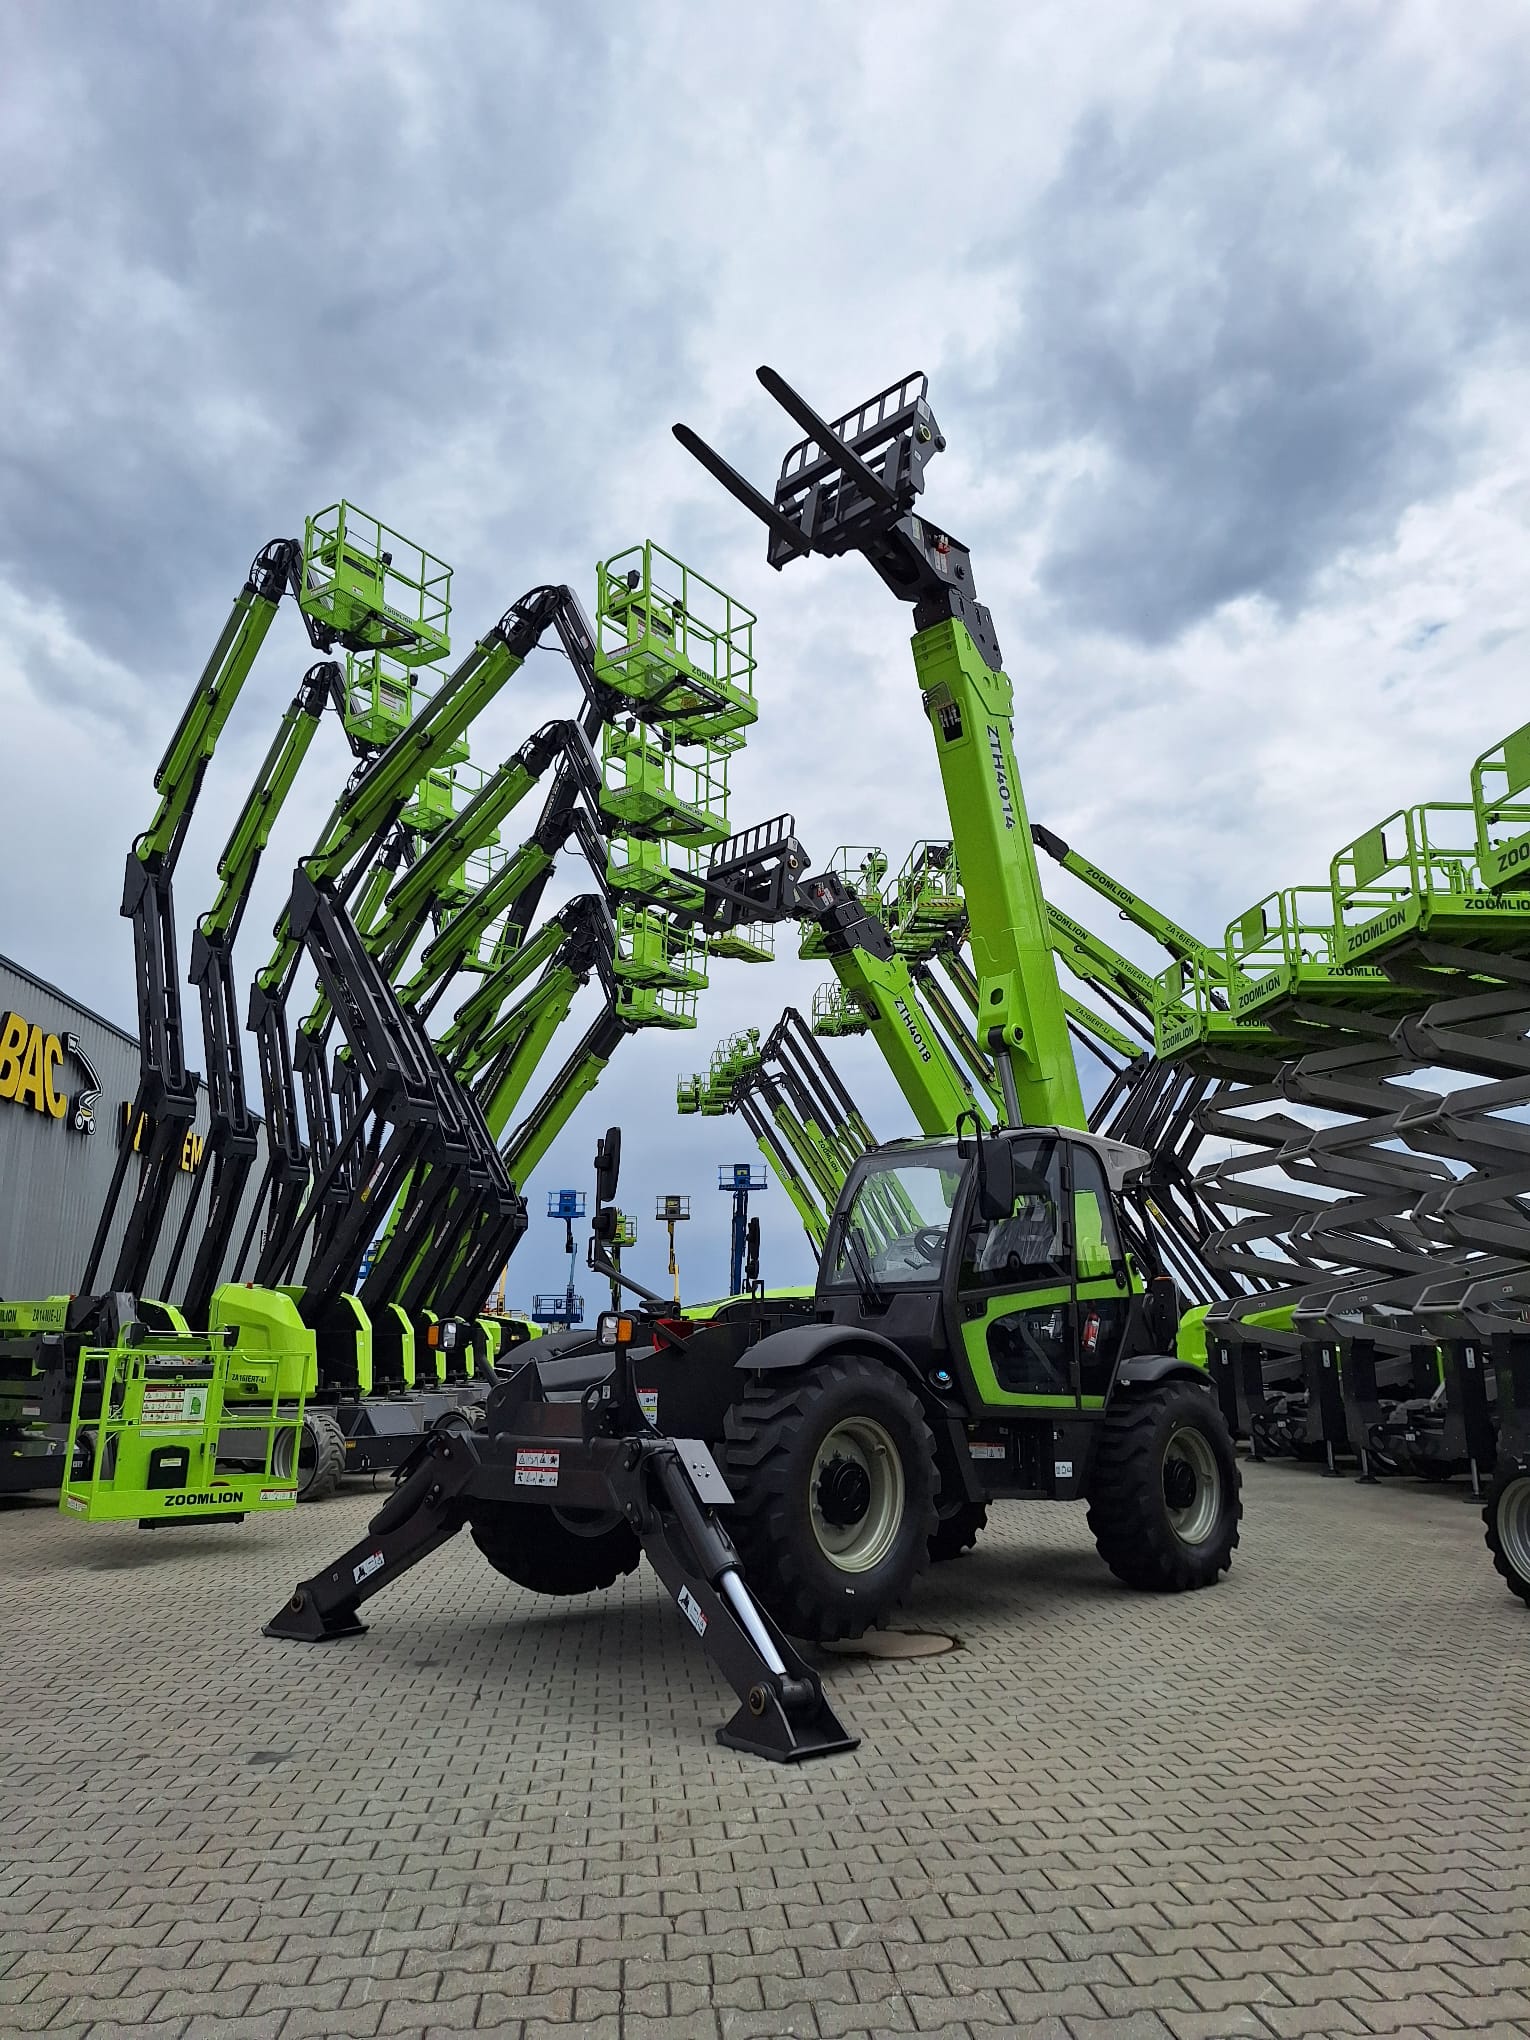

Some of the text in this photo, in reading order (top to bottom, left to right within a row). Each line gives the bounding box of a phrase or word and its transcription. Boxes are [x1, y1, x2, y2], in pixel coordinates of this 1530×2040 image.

[384, 605, 414, 625] ZOOMLION
[691, 665, 728, 693] ZOOMLION
[986, 725, 1016, 829] ZTH4014
[1085, 866, 1135, 905] ZOOMLION
[1046, 905, 1088, 940] ZOOMLION
[1347, 908, 1406, 953] ZOOMLION
[1238, 974, 1281, 1009] ZOOMLION
[894, 995, 931, 1063] ZTH4018
[1162, 1025, 1194, 1051] ZOOMLION
[164, 1491, 243, 1507] ZOOMLION
